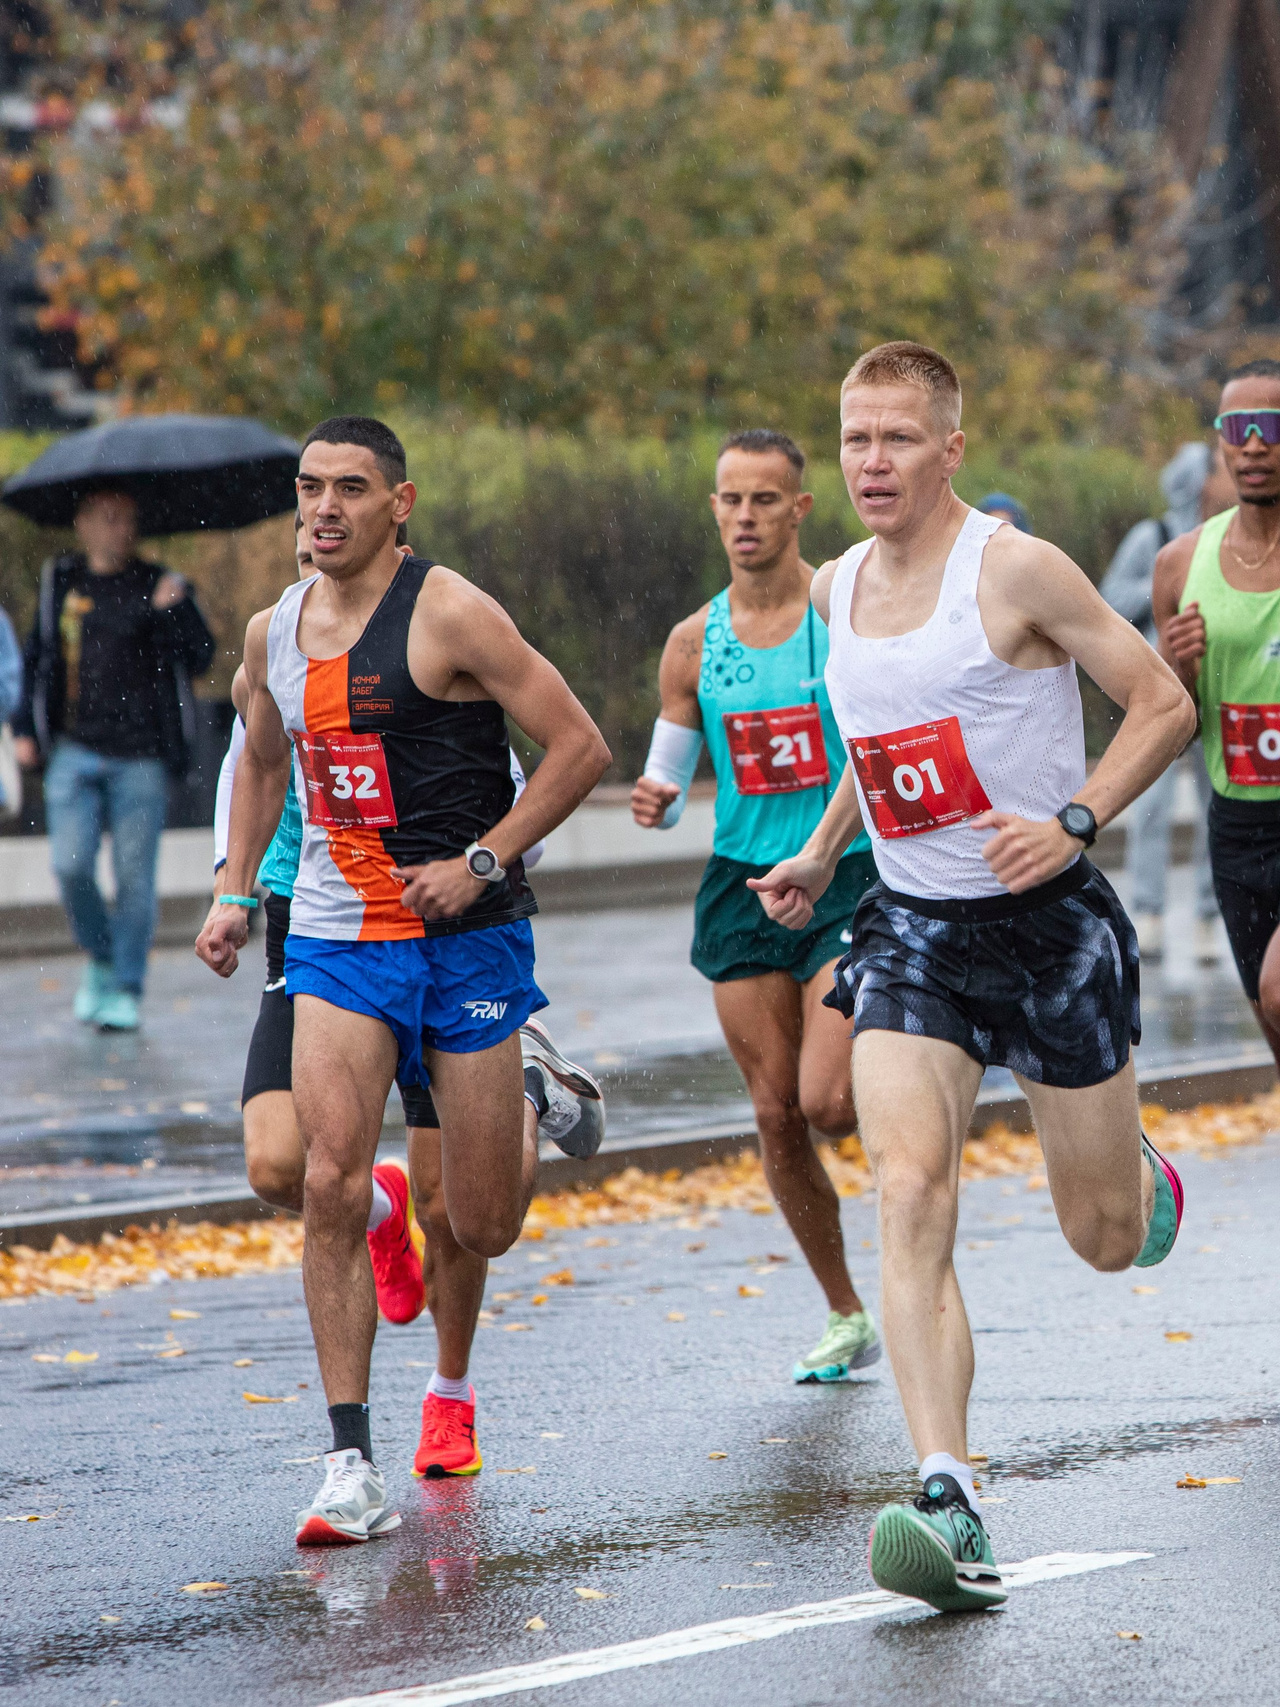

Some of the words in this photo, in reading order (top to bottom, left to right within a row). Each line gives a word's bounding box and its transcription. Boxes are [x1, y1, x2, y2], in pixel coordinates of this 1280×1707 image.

[351, 686, 375, 696] ЗАБЕГ
[352, 674, 380, 685] НОЧНОЙ
[768, 730, 813, 768] 21
[328, 764, 381, 800] 32
[892, 757, 945, 802] 01
